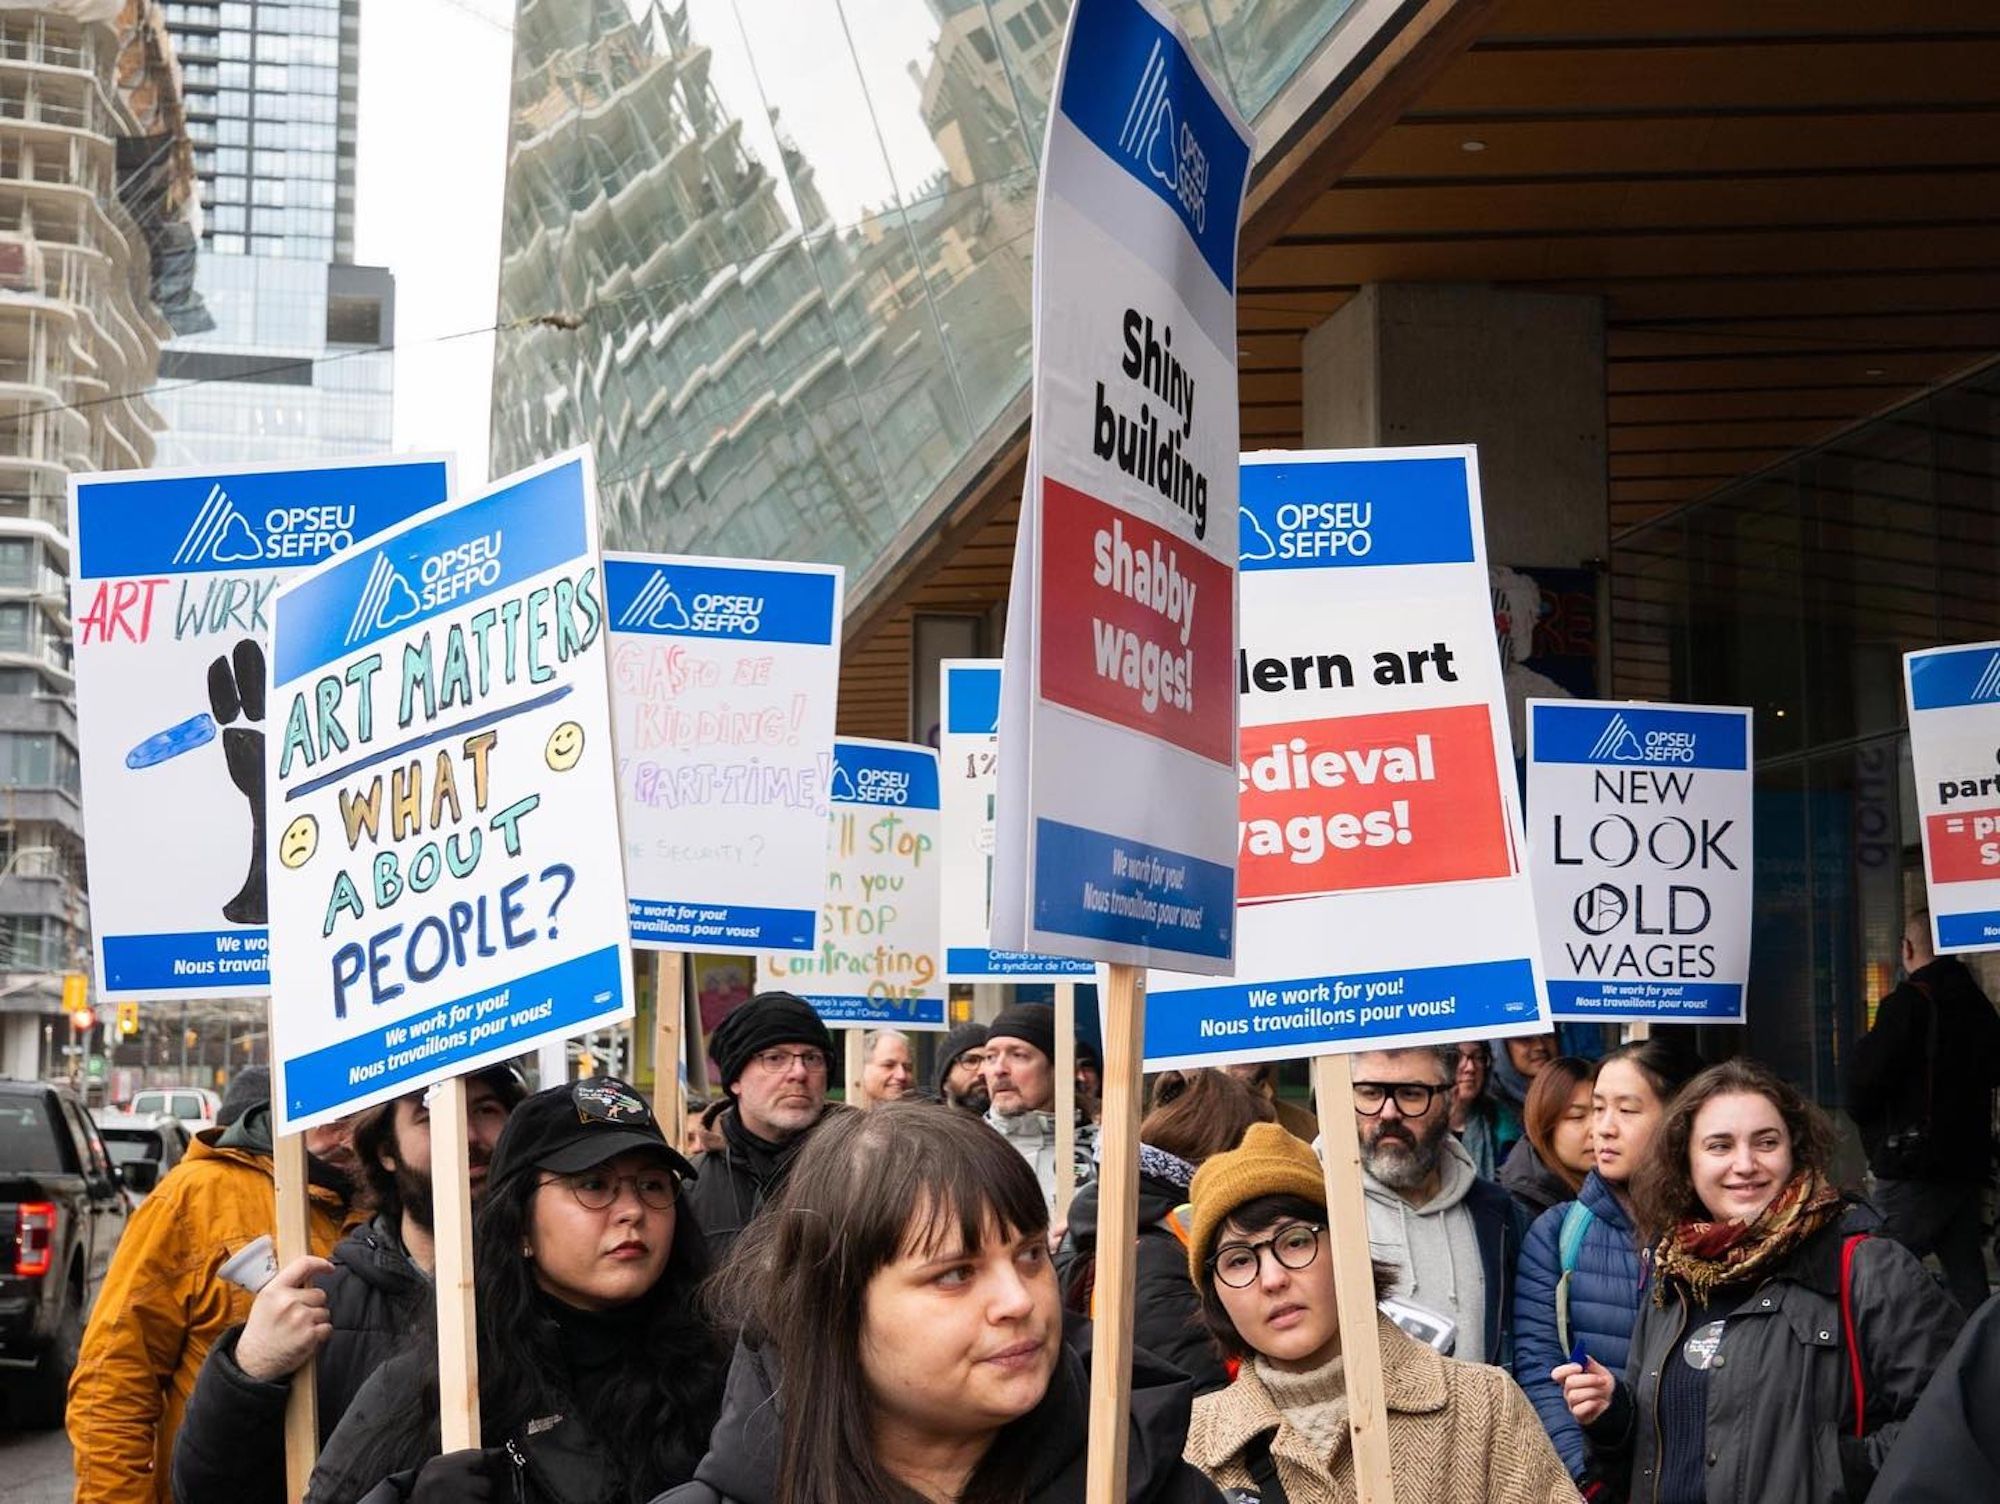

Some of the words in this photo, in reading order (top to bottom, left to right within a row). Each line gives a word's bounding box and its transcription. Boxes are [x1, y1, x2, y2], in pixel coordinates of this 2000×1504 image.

[1181, 122, 1209, 195] OPSEU
[1177, 162, 1205, 234] SEFPO
[1122, 308, 1195, 438] Shiny
[1093, 381, 1207, 540] building
[265, 505, 356, 534] OPSEU
[1276, 502, 1372, 531] OPSEU
[265, 530, 354, 559] SEFPO
[421, 530, 502, 584] OPSEU
[1278, 529, 1371, 558] SEFPO
[421, 559, 501, 613] SEFPO
[1093, 518, 1197, 645] shabby
[79, 578, 170, 645] ART
[692, 593, 764, 616] OPSEU
[691, 612, 760, 635] SEFPO
[279, 654, 382, 778] ART
[398, 567, 602, 729] MATTERS
[733, 655, 774, 687] BE
[1093, 616, 1194, 714] wages!
[1373, 643, 1458, 686] art
[1644, 745, 1694, 762] SEFPO
[1645, 731, 1696, 748] OPSEU
[339, 730, 498, 849] WHAT
[857, 768, 910, 789] OPSEU
[857, 786, 907, 805] SEFPO
[1594, 769, 1694, 804] NEW
[1238, 800, 1412, 864] ages!
[1553, 813, 1738, 870] LOOK
[322, 794, 540, 937] ABOUT
[1112, 848, 1128, 877] We
[1128, 855, 1150, 882] work
[1149, 856, 1166, 889] for
[1164, 866, 1185, 892] you!
[860, 873, 904, 901] you
[644, 904, 676, 918] work
[676, 906, 697, 920] for
[699, 908, 728, 922] you!
[1083, 882, 1110, 912] Nous
[1110, 888, 1158, 921] travaillons
[1157, 902, 1181, 929] pour
[1180, 906, 1203, 929] vous!
[1573, 882, 1712, 935] OLD
[216, 936, 241, 952] We
[244, 938, 268, 951] wo
[332, 863, 575, 1019] PEOPLE?
[630, 919, 690, 934] ravaillons
[693, 923, 724, 937] pour
[725, 926, 760, 938] vous!
[174, 959, 215, 975] Nous
[988, 961, 1000, 970] Le
[1002, 961, 1043, 973] syndicat
[1045, 961, 1058, 970] de
[1565, 942, 1716, 978] WAGES
[839, 999, 863, 1007] union
[868, 980, 926, 1018] OUT
[1248, 990, 1277, 1008] We
[1282, 984, 1330, 1004] work
[1332, 981, 1362, 1004] for
[1366, 977, 1404, 1001] you!
[1576, 997, 1601, 1007] Nous
[1603, 997, 1656, 1008] travaillons
[1658, 1000, 1681, 1010] pour
[1683, 999, 1708, 1009] vous!
[1602, 985, 1618, 995] We
[1619, 985, 1644, 995] work
[1645, 985, 1661, 997] for
[1662, 987, 1684, 997] you!
[385, 1027, 408, 1048] We
[409, 1010, 447, 1039] work
[447, 1005, 473, 1029] for
[476, 988, 510, 1018] you!
[845, 1009, 856, 1017] de
[1200, 1019, 1249, 1037] Nous
[1253, 1006, 1355, 1031] travaillons
[1360, 1004, 1404, 1026] pour
[1407, 997, 1456, 1017] vous!
[349, 1059, 385, 1085] Nous
[387, 1030, 467, 1071] travaillons
[469, 1016, 508, 1046] pour
[510, 998, 553, 1028] vous!
